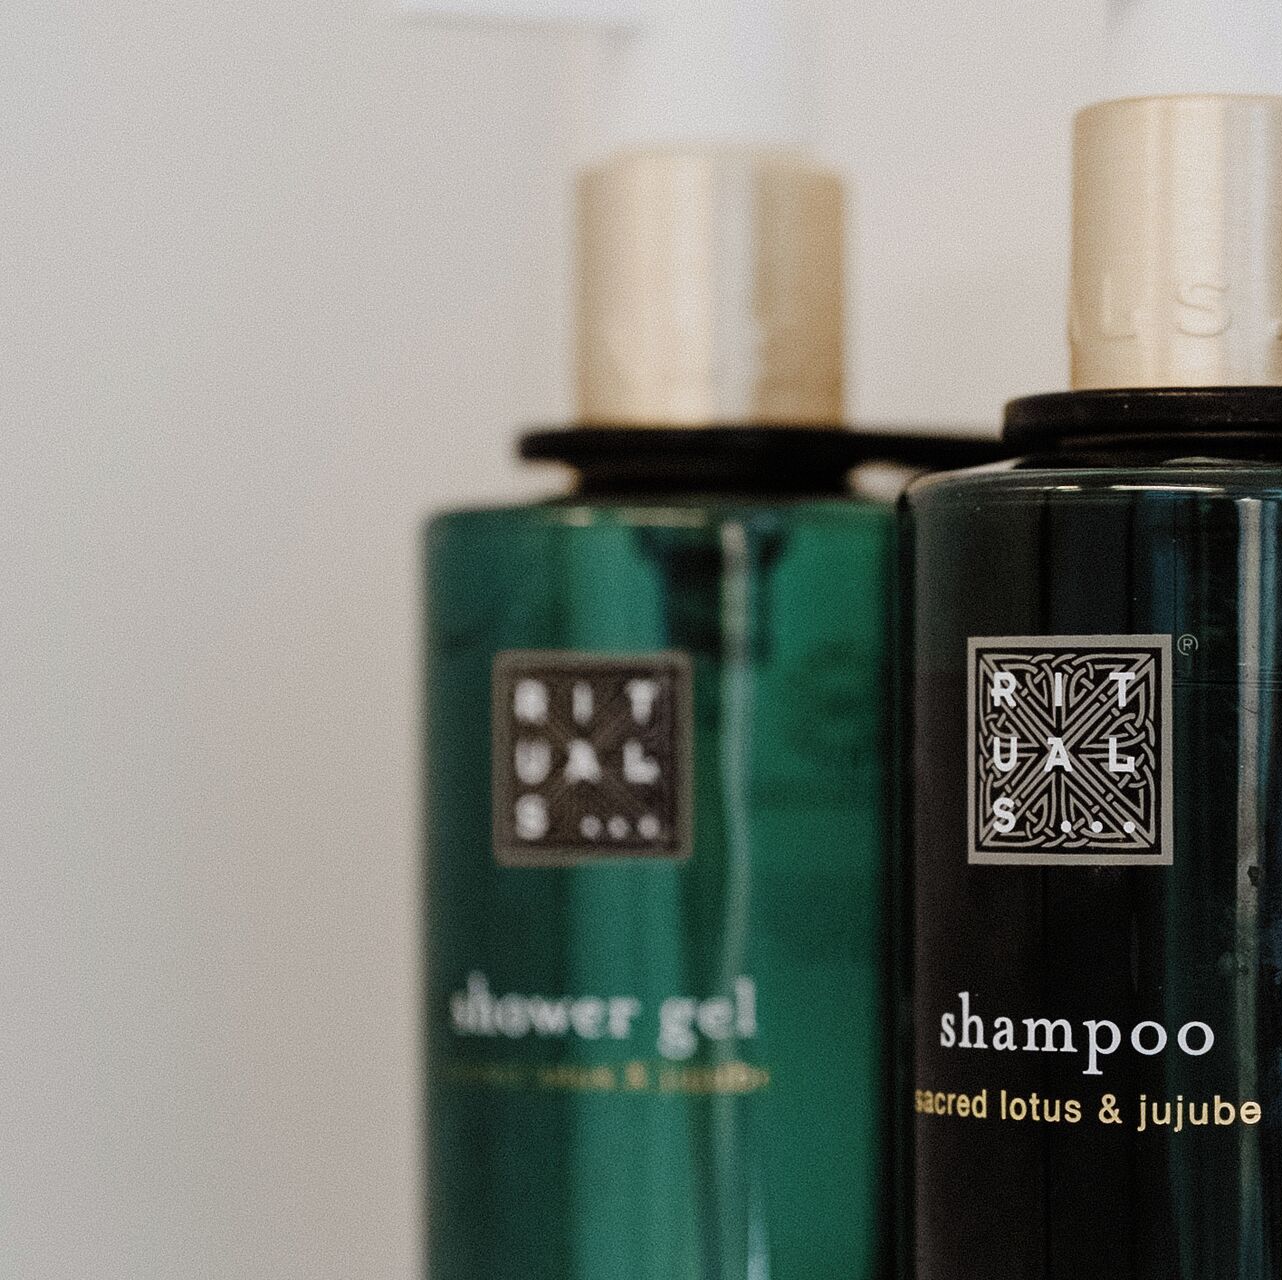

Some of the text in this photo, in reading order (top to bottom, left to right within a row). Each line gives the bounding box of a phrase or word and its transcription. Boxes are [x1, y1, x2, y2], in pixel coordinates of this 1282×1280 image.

[658, 974, 759, 1061] gel
[940, 991, 1215, 1076] shampoo
[915, 1089, 1263, 1132] sacred lotus & jujube
